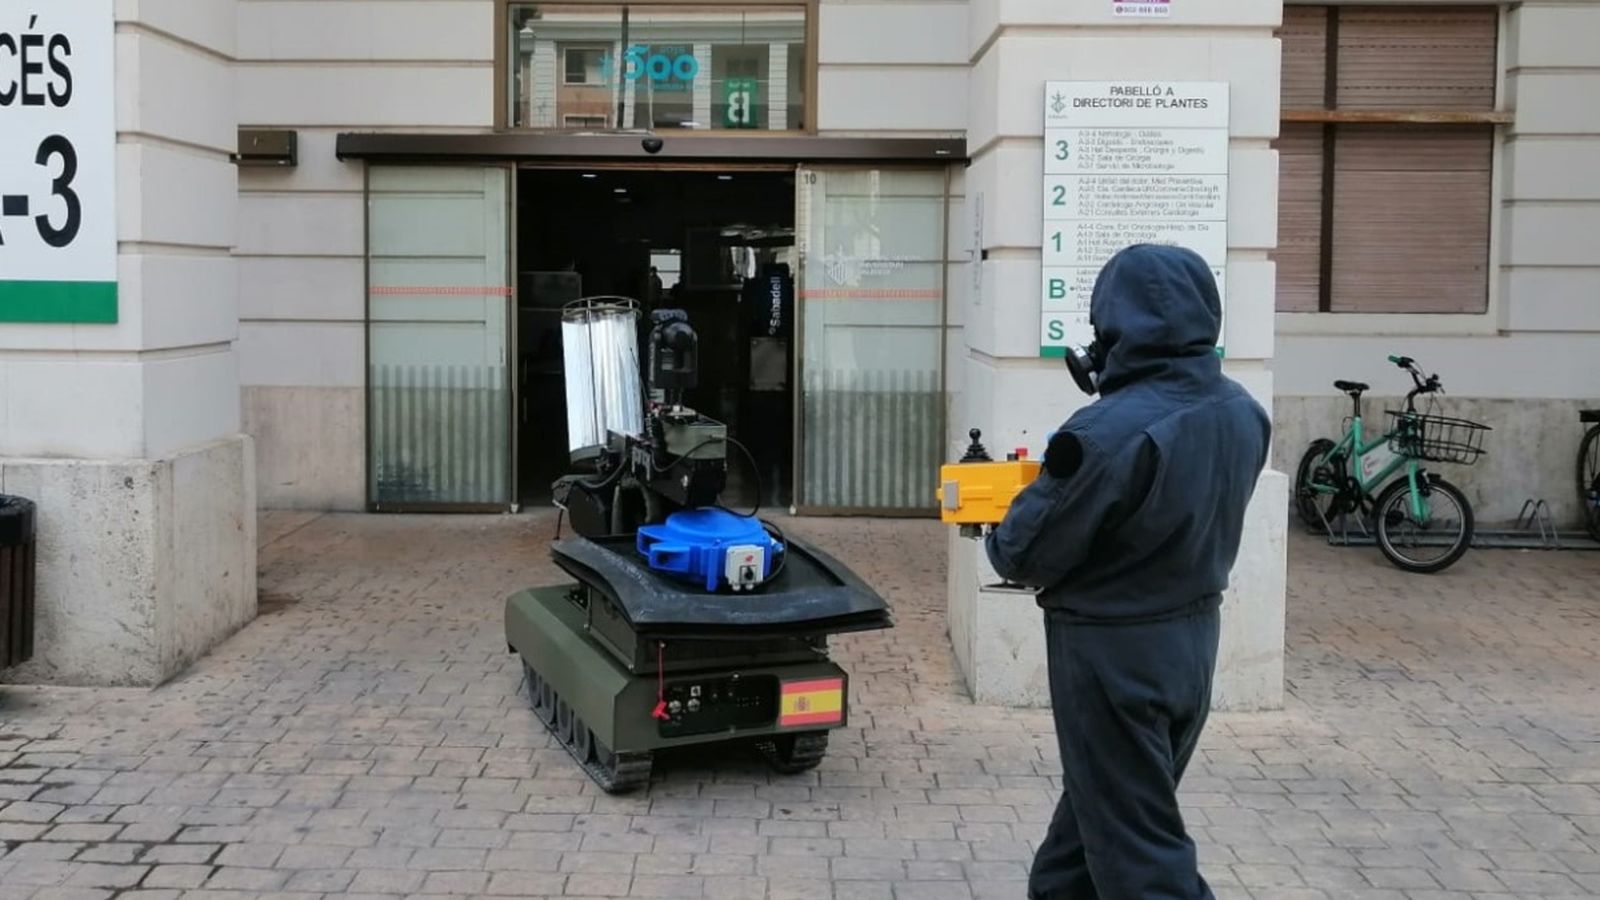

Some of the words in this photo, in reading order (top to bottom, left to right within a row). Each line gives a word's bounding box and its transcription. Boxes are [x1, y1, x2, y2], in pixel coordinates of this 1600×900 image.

[1110, 85, 1162, 97] PABELLÓ
[1165, 86, 1175, 97] A
[1073, 98, 1134, 109] DIRECTORI
[1136, 98, 1153, 109] DE
[1155, 98, 1209, 109] PLANTES
[1055, 140, 1069, 161] 3
[804, 173, 817, 184] 10
[0, 134, 82, 248] -3
[1052, 185, 1066, 206] 2
[1051, 232, 1062, 252] 1
[1049, 278, 1066, 299] B
[769, 276, 782, 328] Sabadell
[1048, 320, 1065, 341] S
